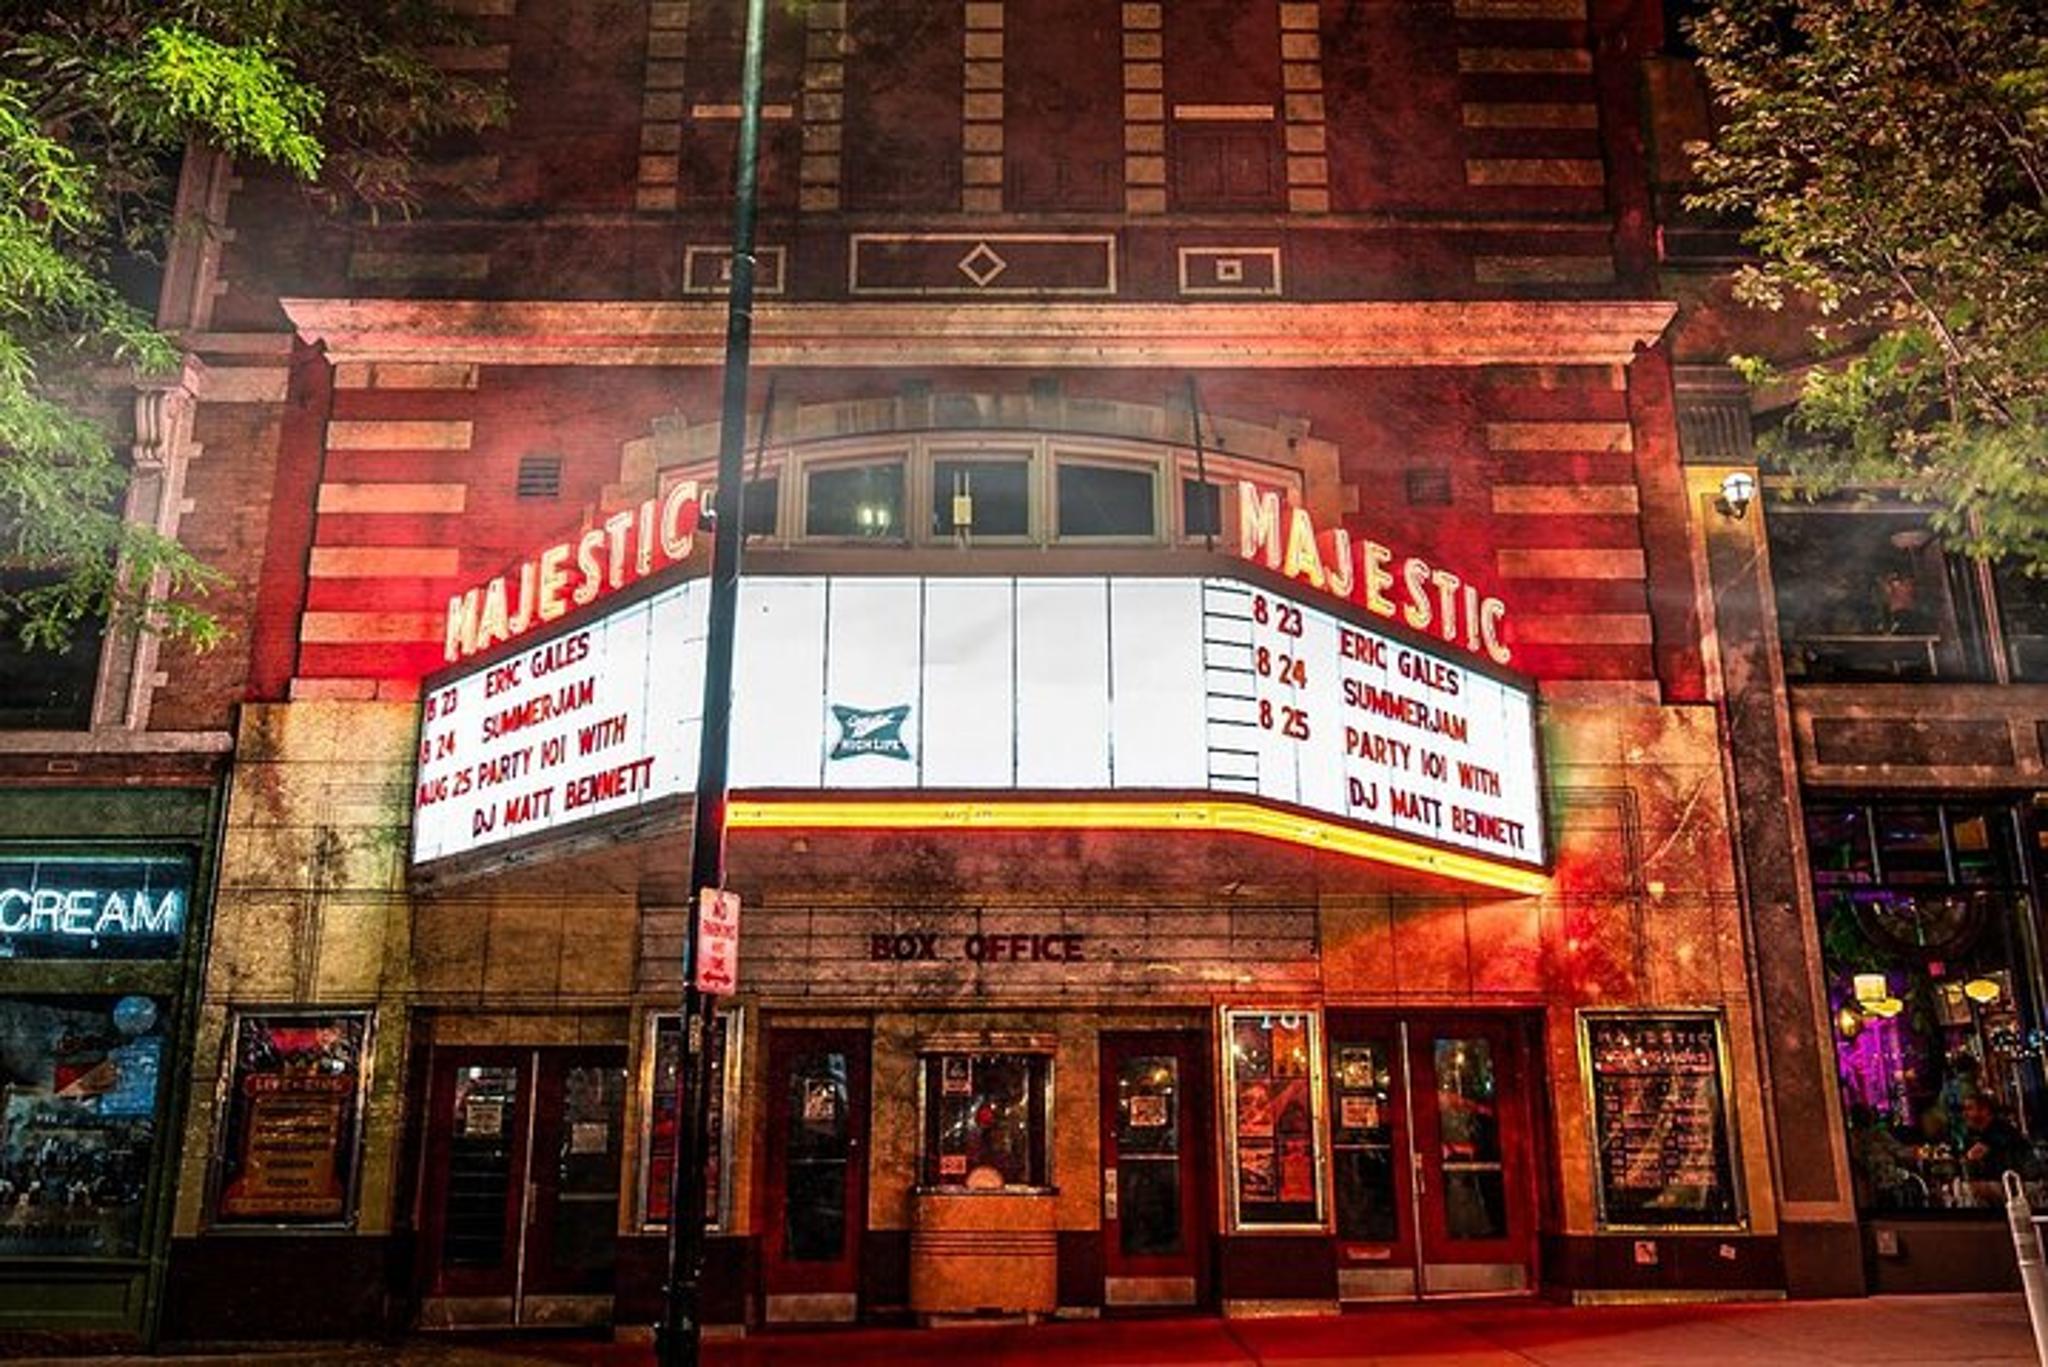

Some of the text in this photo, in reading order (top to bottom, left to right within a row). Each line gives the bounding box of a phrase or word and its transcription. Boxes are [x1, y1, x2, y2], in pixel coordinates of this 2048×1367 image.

[444, 480, 699, 662] MAJESTIC
[1239, 480, 1511, 664] MAJESTIC
[441, 687, 457, 718] 23
[484, 657, 522, 699] ERIC
[531, 632, 591, 680] GALES
[1253, 595, 1460, 697] 8 23 ERIC GALES
[436, 730, 455, 760] 24
[481, 676, 596, 744] SUMMERJAM
[1256, 646, 1468, 745] 8 24 SUMMERJAM
[416, 775, 448, 810] AUG
[452, 766, 473, 797] 25
[478, 745, 533, 791] PARTY
[579, 713, 628, 756] WITH
[1259, 699, 1273, 730] 8
[1282, 707, 1310, 742] 25
[1346, 726, 1411, 773] PARTY
[1458, 762, 1502, 799] WITH
[472, 756, 656, 838] DJ MATT BENNETT
[1349, 776, 1526, 852] DJ MATT BENNETT
[0, 889, 173, 934] CREAM
[871, 933, 1085, 962] BOX OFFICE
